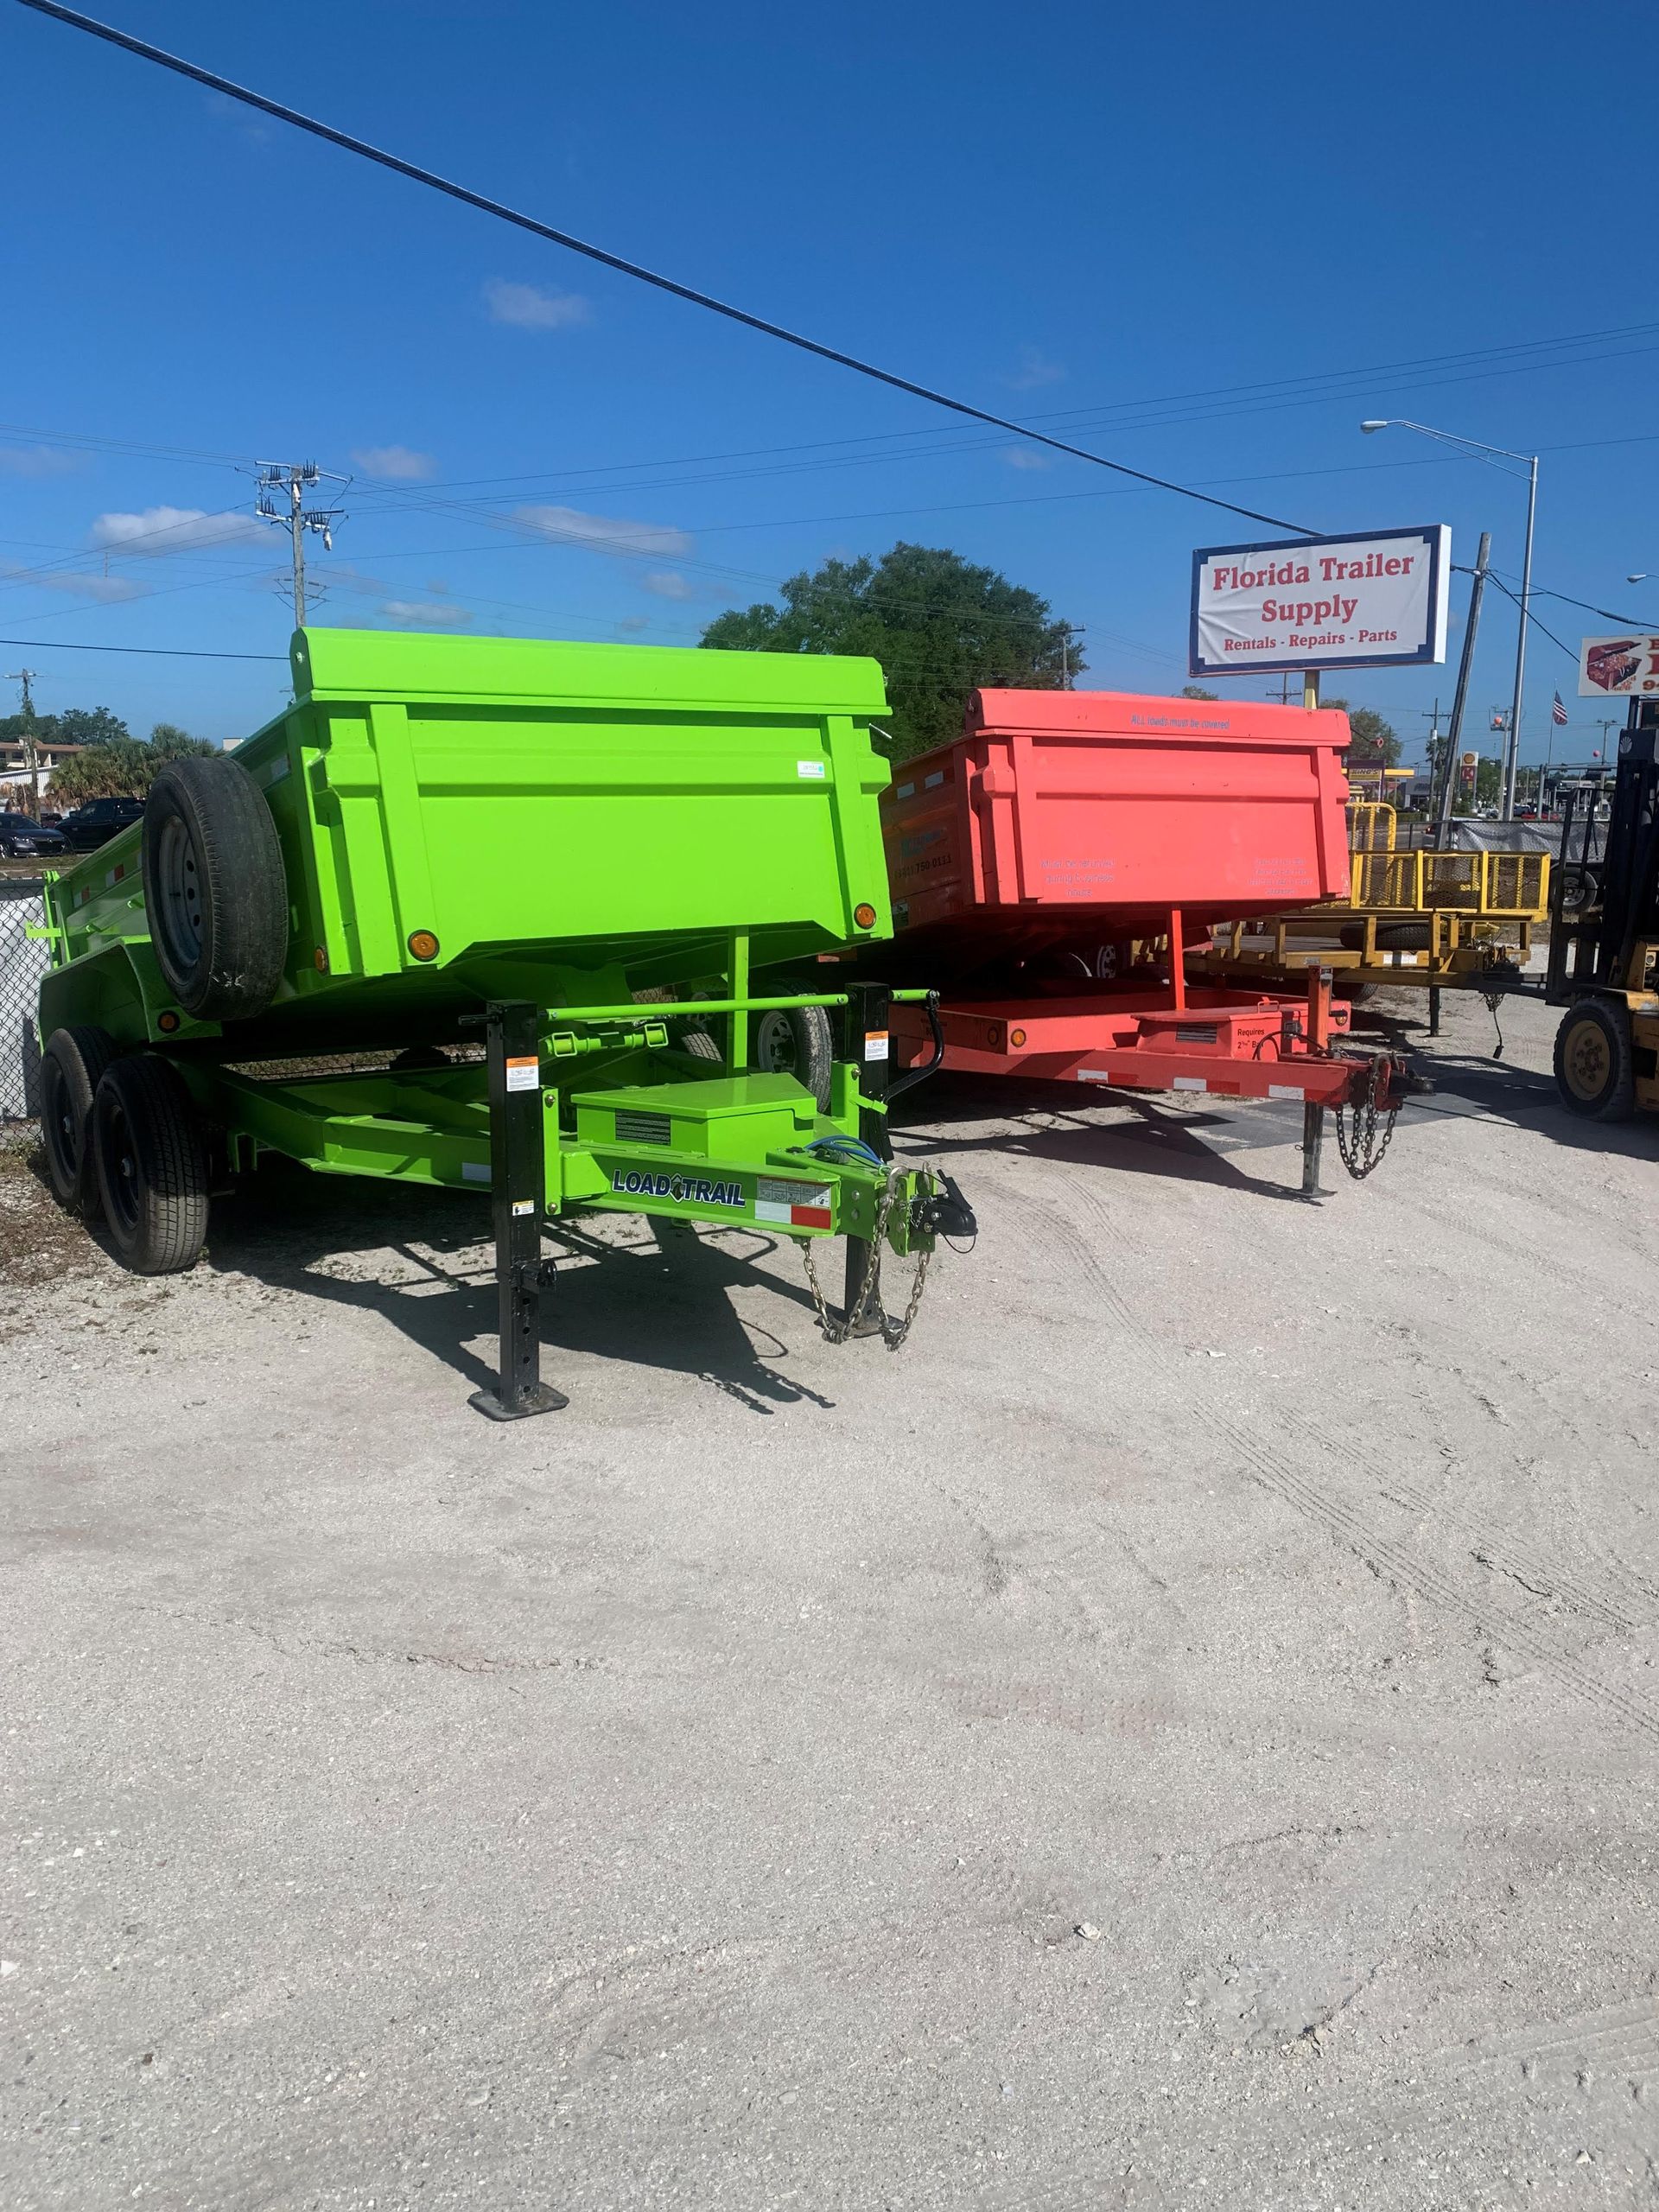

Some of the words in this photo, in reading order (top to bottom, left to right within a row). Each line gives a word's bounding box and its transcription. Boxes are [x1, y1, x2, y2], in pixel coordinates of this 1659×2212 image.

[1212, 561, 1310, 590] Florida
[1319, 553, 1414, 582] Trailer
[1262, 594, 1358, 626] Supply
[1224, 636, 1276, 651] Rentals
[1288, 632, 1345, 649] Repairs
[1358, 629, 1397, 642] Parts
[1237, 1028, 1265, 1037] Requires
[612, 1168, 672, 1198] LOAD
[681, 1176, 746, 1208] TRAIL
